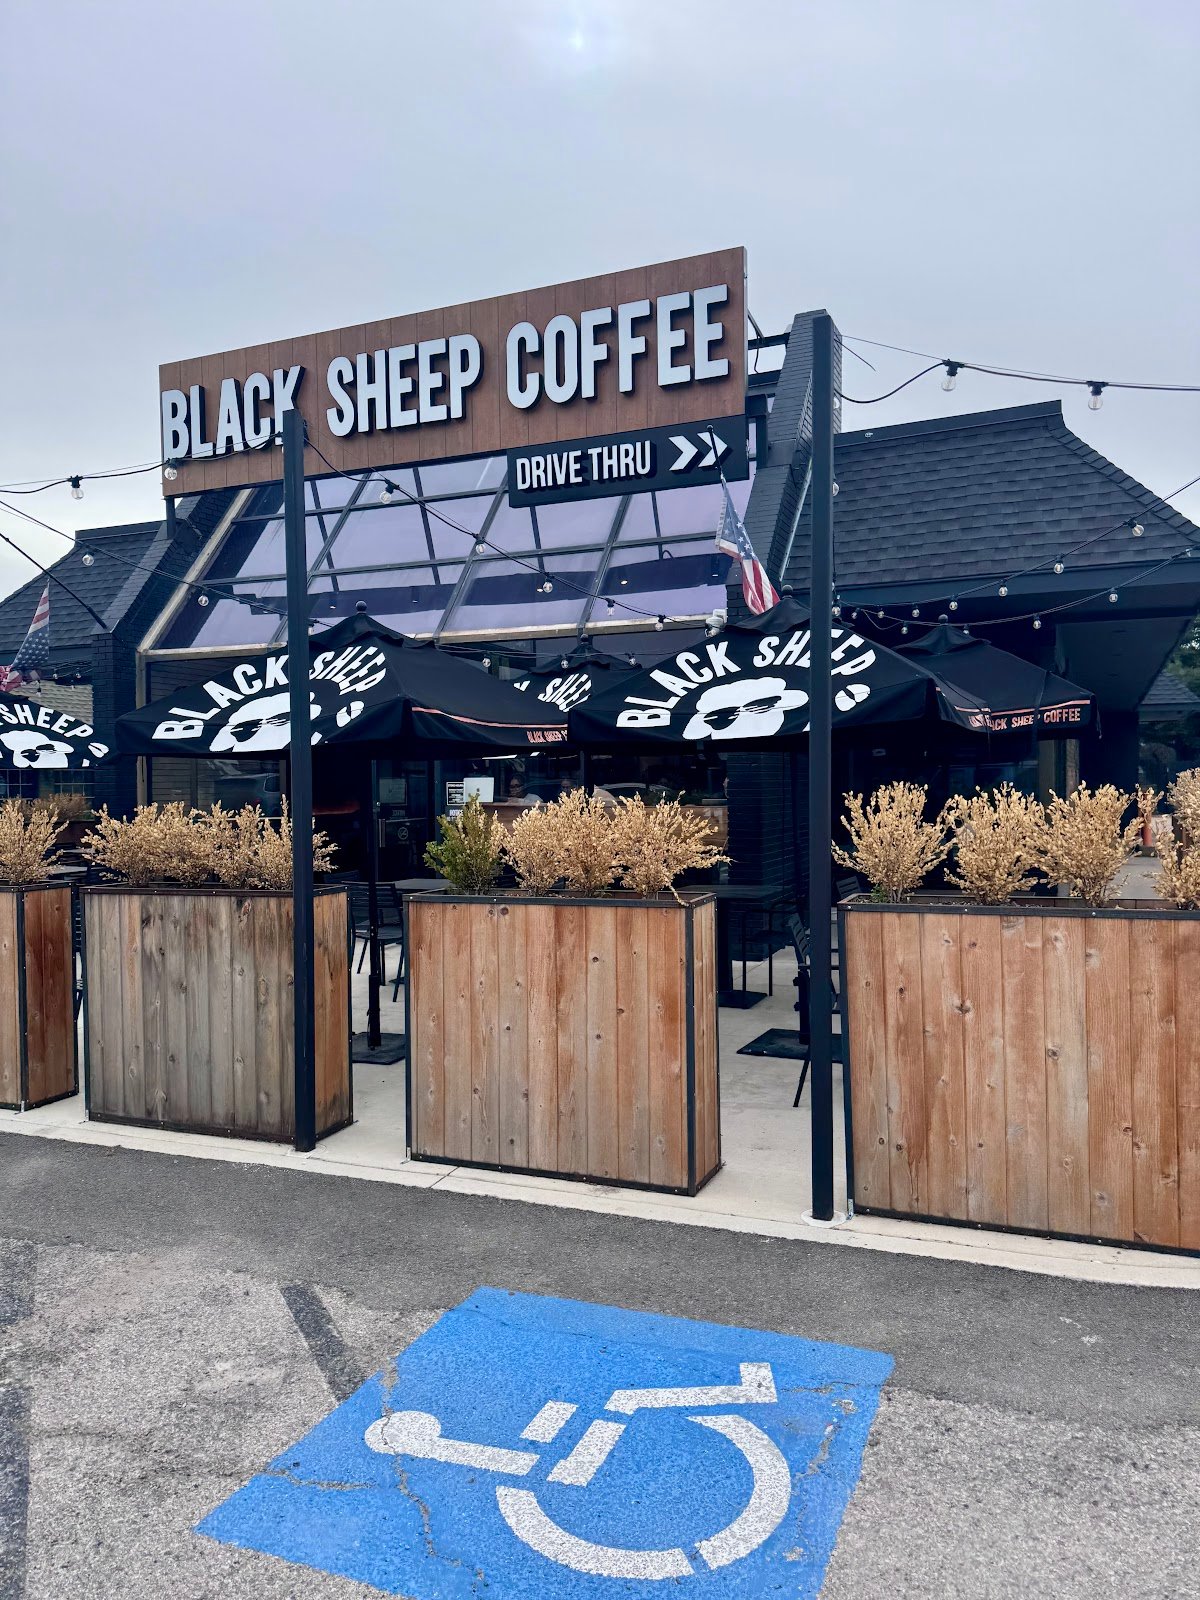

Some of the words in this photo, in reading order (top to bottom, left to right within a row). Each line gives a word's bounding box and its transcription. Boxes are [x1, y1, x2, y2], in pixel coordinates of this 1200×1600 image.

[162, 365, 304, 459] BLACK
[326, 333, 482, 437] SHEEP
[506, 284, 729, 409] COFFEE
[516, 450, 583, 490] DRIVE
[588, 440, 651, 480] THRU
[152, 654, 290, 739] BLACK
[309, 646, 387, 696] SHEEP
[616, 641, 741, 728] BLACK
[1011, 714, 1041, 728] SHEE
[1043, 708, 1081, 723] COFFEE
[0, 703, 94, 738] SHEEP
